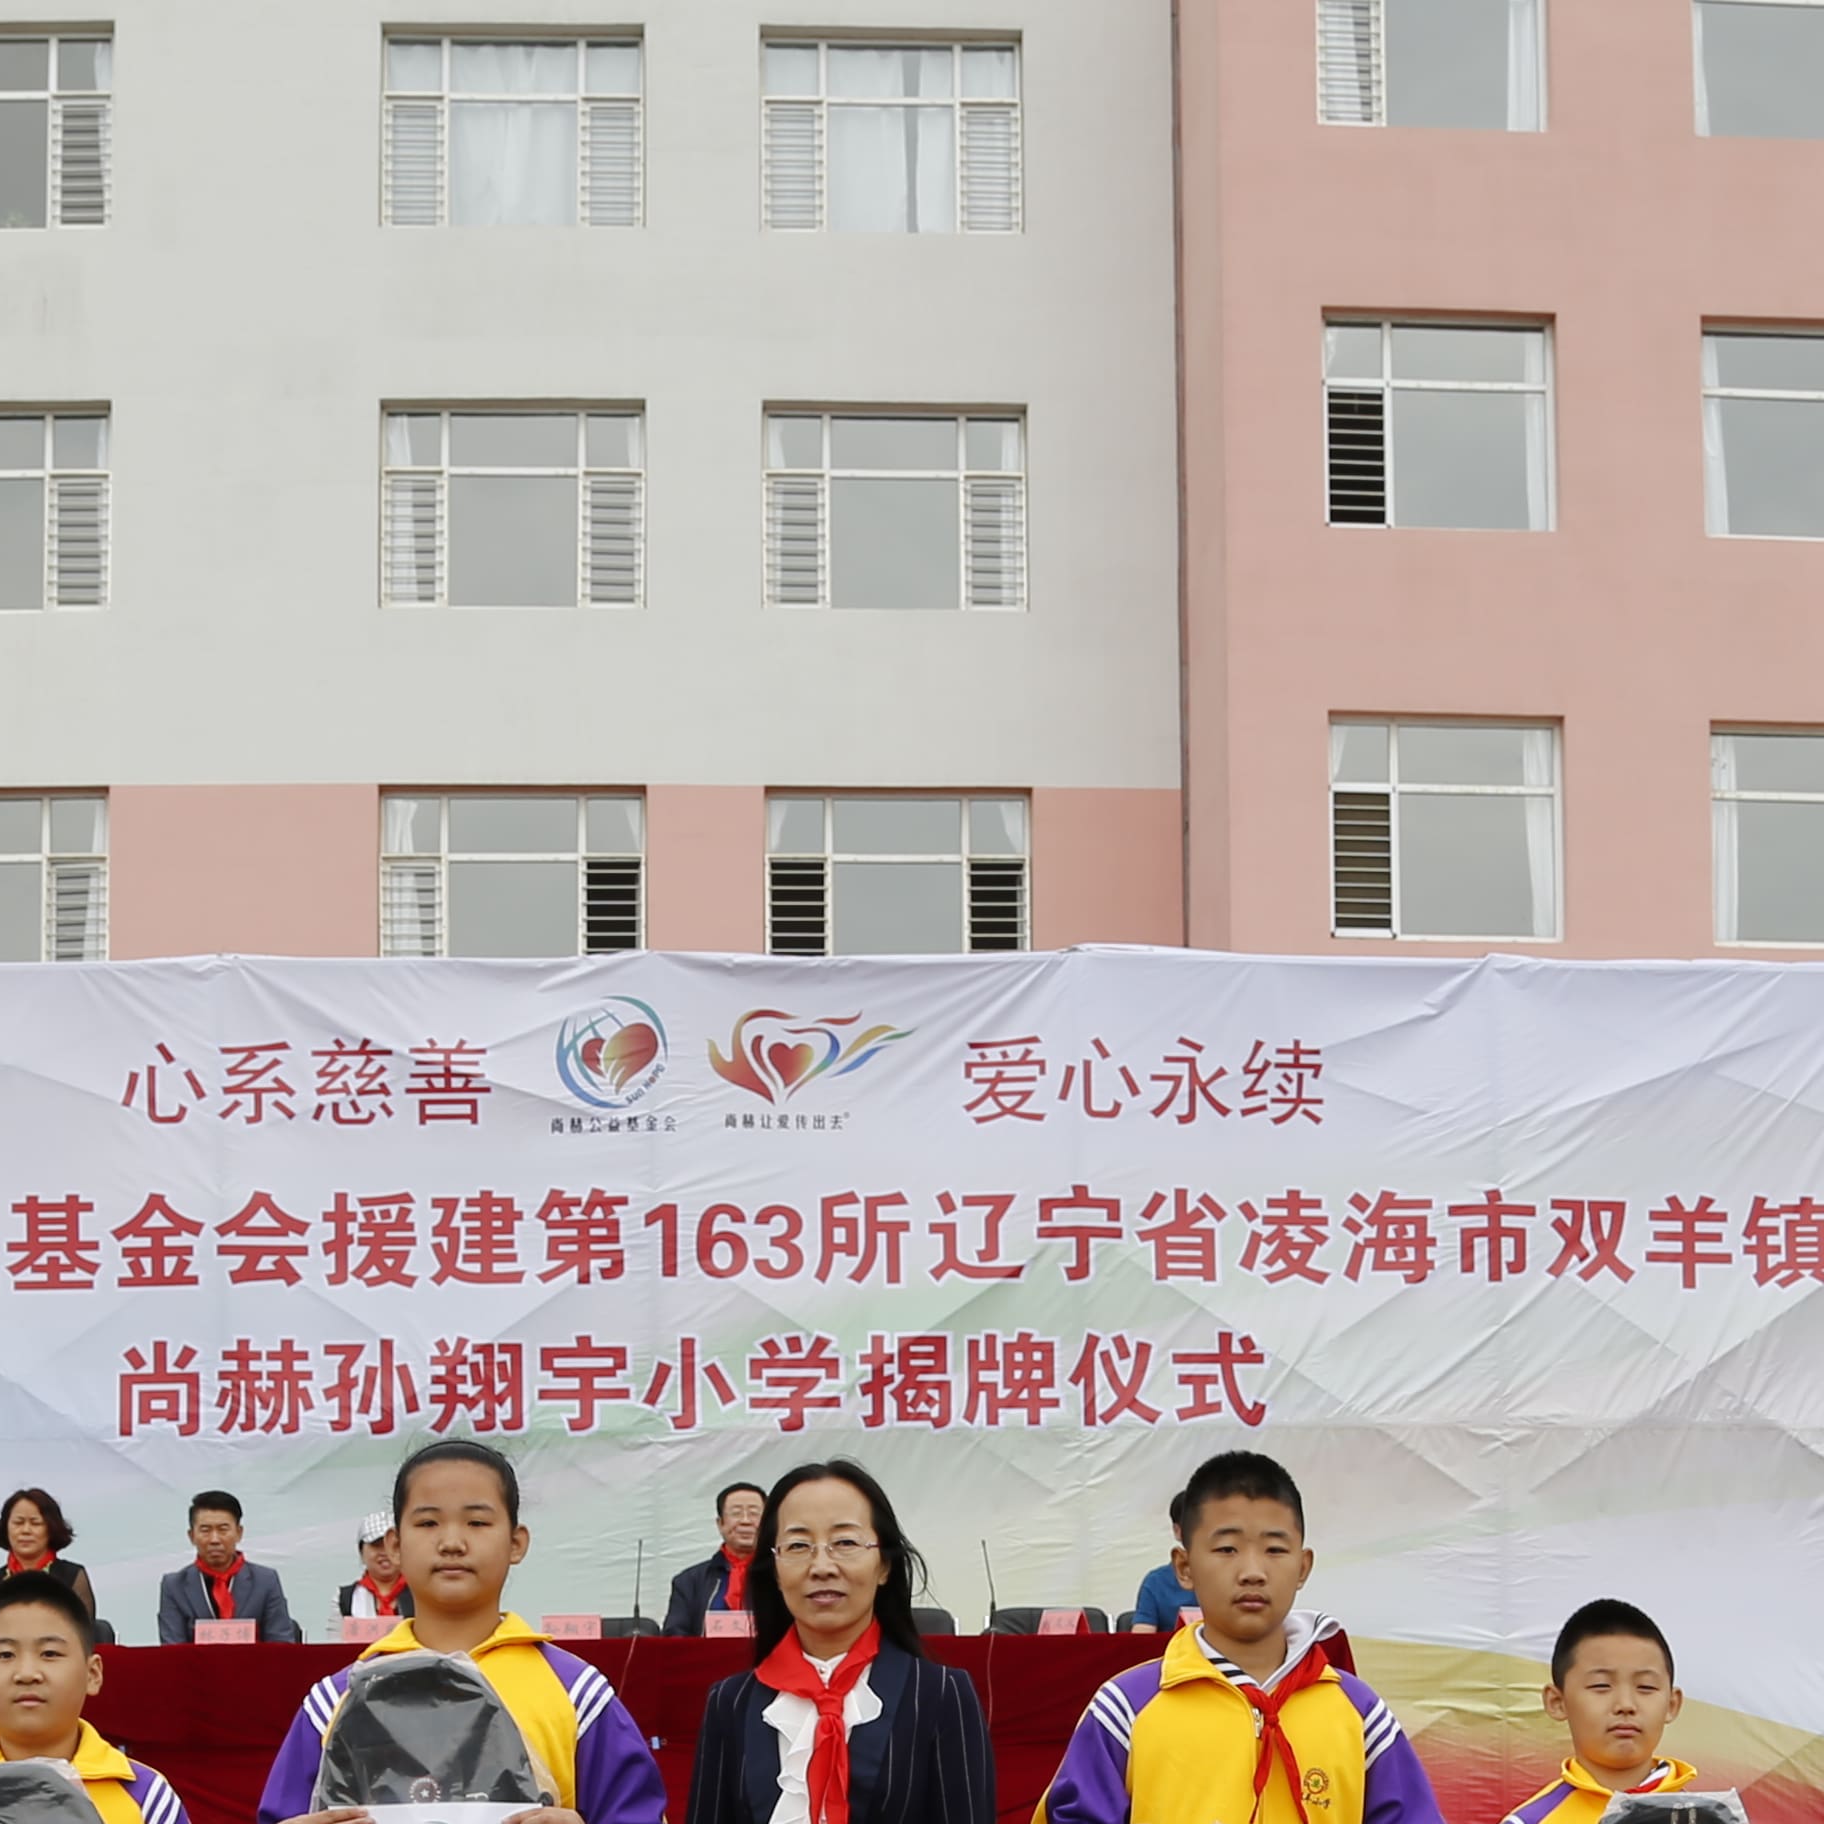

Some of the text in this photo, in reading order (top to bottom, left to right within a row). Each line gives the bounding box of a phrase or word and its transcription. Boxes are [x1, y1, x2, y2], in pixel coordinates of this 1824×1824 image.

[120, 1037, 494, 1128] 心系慈善
[550, 1115, 677, 1134] 尚赫公益基金会
[963, 1035, 1326, 1128] 爱心永续
[117, 1329, 1267, 1438] 尚赫孙翔宇小学揭牌仪式
